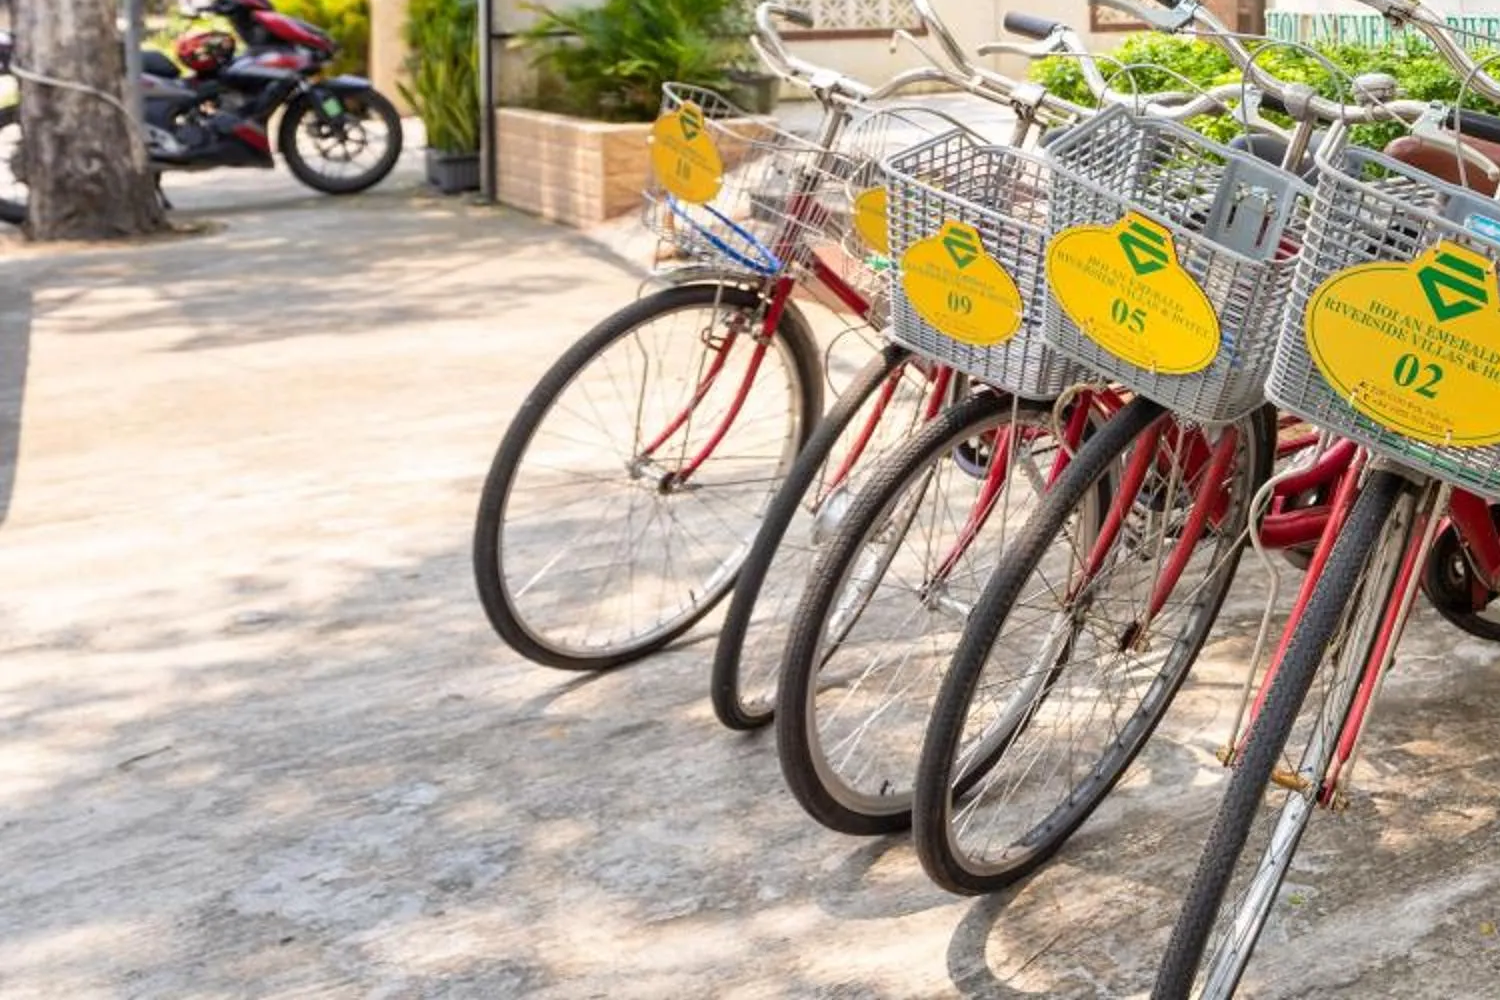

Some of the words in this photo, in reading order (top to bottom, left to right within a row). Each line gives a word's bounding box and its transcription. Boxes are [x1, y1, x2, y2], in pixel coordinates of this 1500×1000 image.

[947, 291, 972, 315] 09
[1111, 298, 1147, 335] 05
[1369, 299, 1397, 324] HOI
[1397, 314, 1423, 333] AN
[1324, 296, 1409, 341] RIVERSIDE
[1411, 333, 1466, 366] VILLAS
[1466, 360, 1479, 372] &
[1393, 352, 1444, 399] 02
